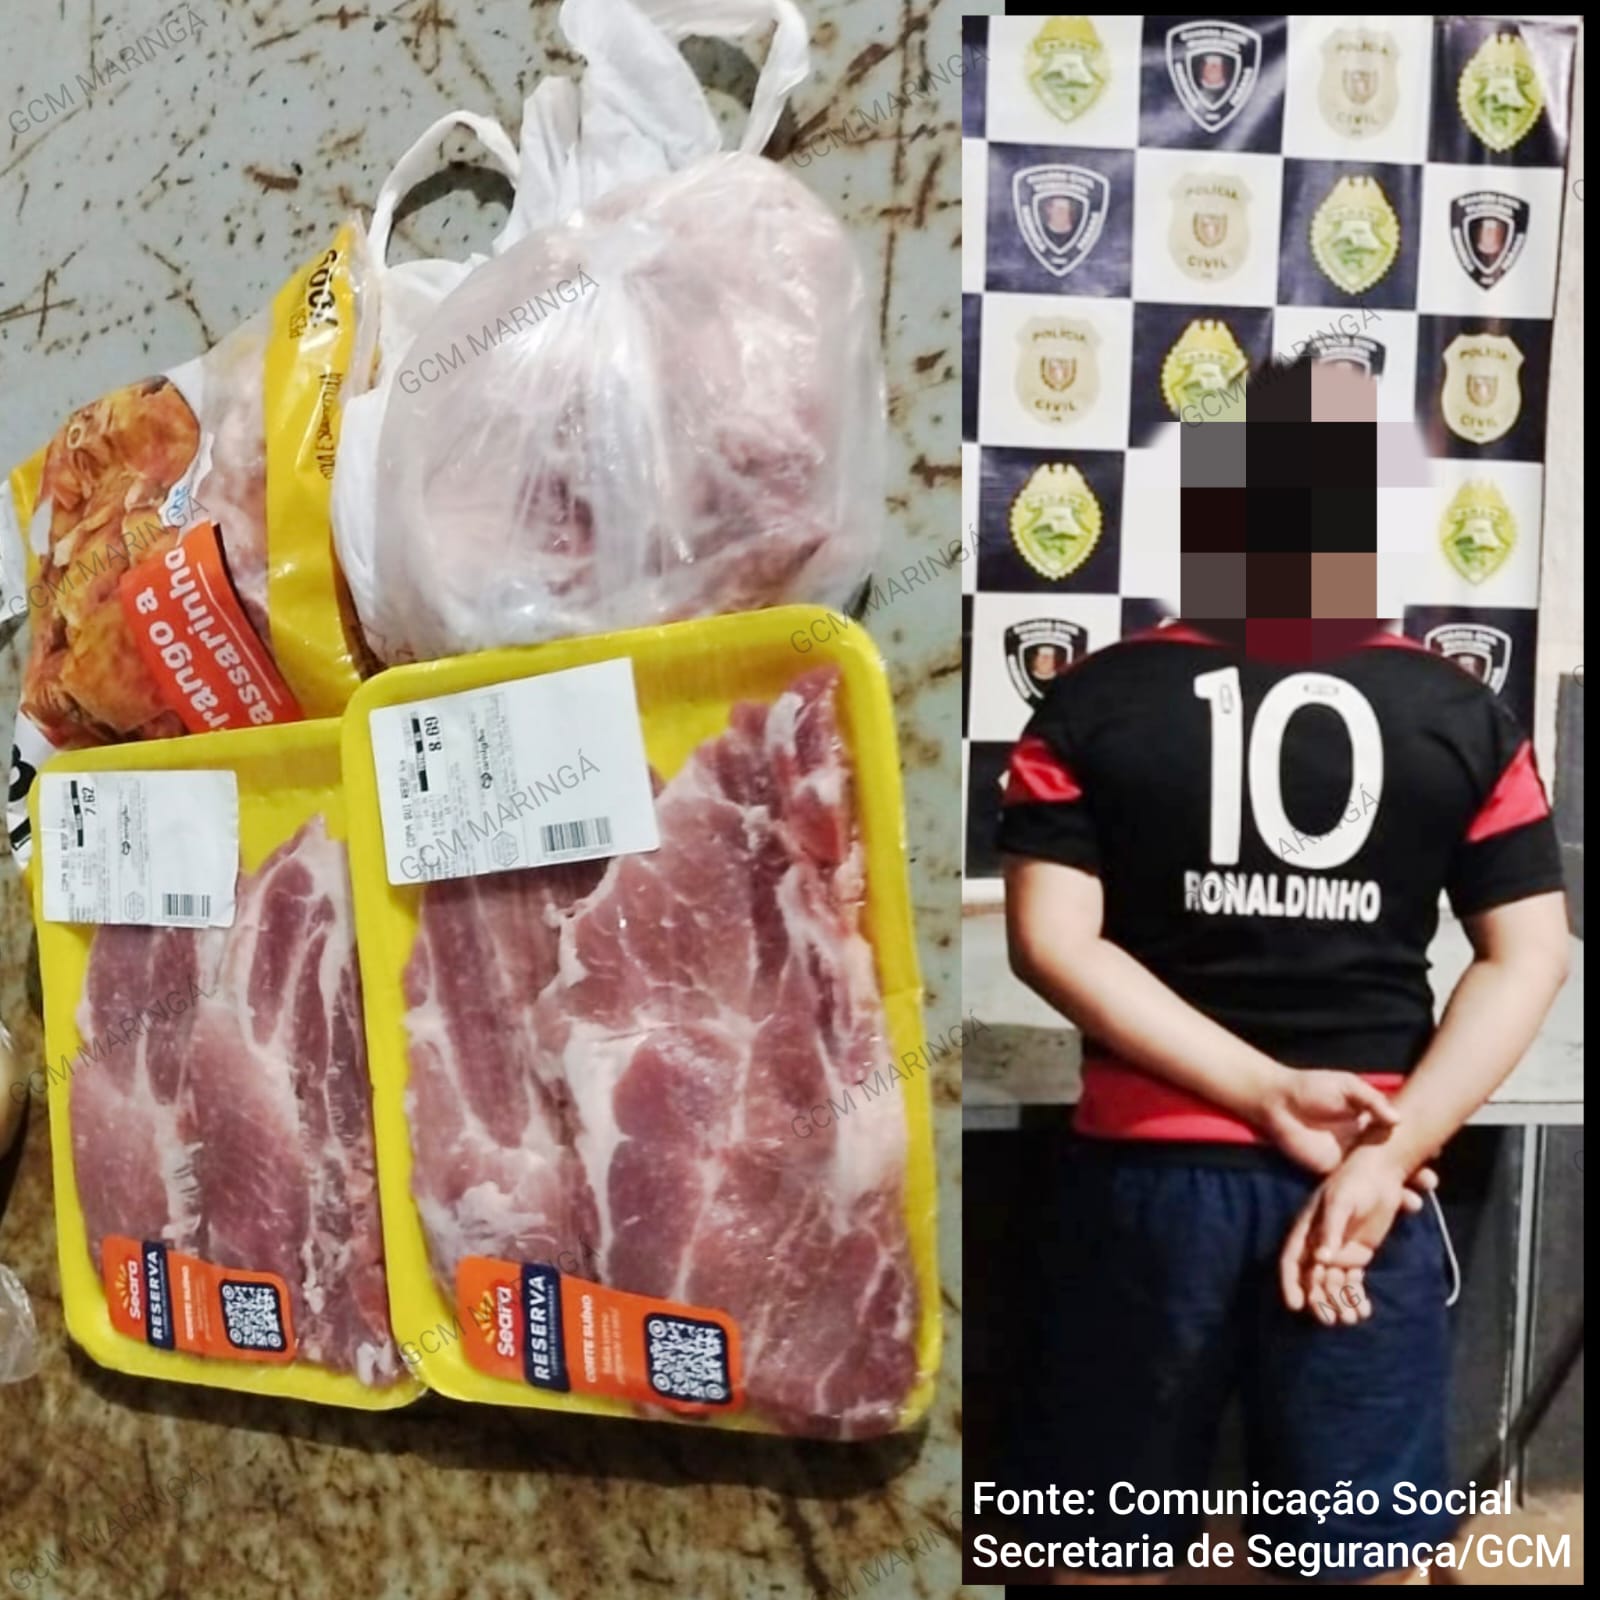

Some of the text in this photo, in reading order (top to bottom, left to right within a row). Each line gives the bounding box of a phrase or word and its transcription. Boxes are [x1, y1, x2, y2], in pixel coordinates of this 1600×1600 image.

[136, 586, 230, 728] rango a
[164, 546, 274, 725] assarinho
[1194, 666, 1384, 869] 10
[1184, 870, 1381, 924] RONALDINHO
[147, 1251, 163, 1341] RESERVA
[496, 1286, 515, 1357] Seara
[529, 1275, 551, 1381] RESERVA
